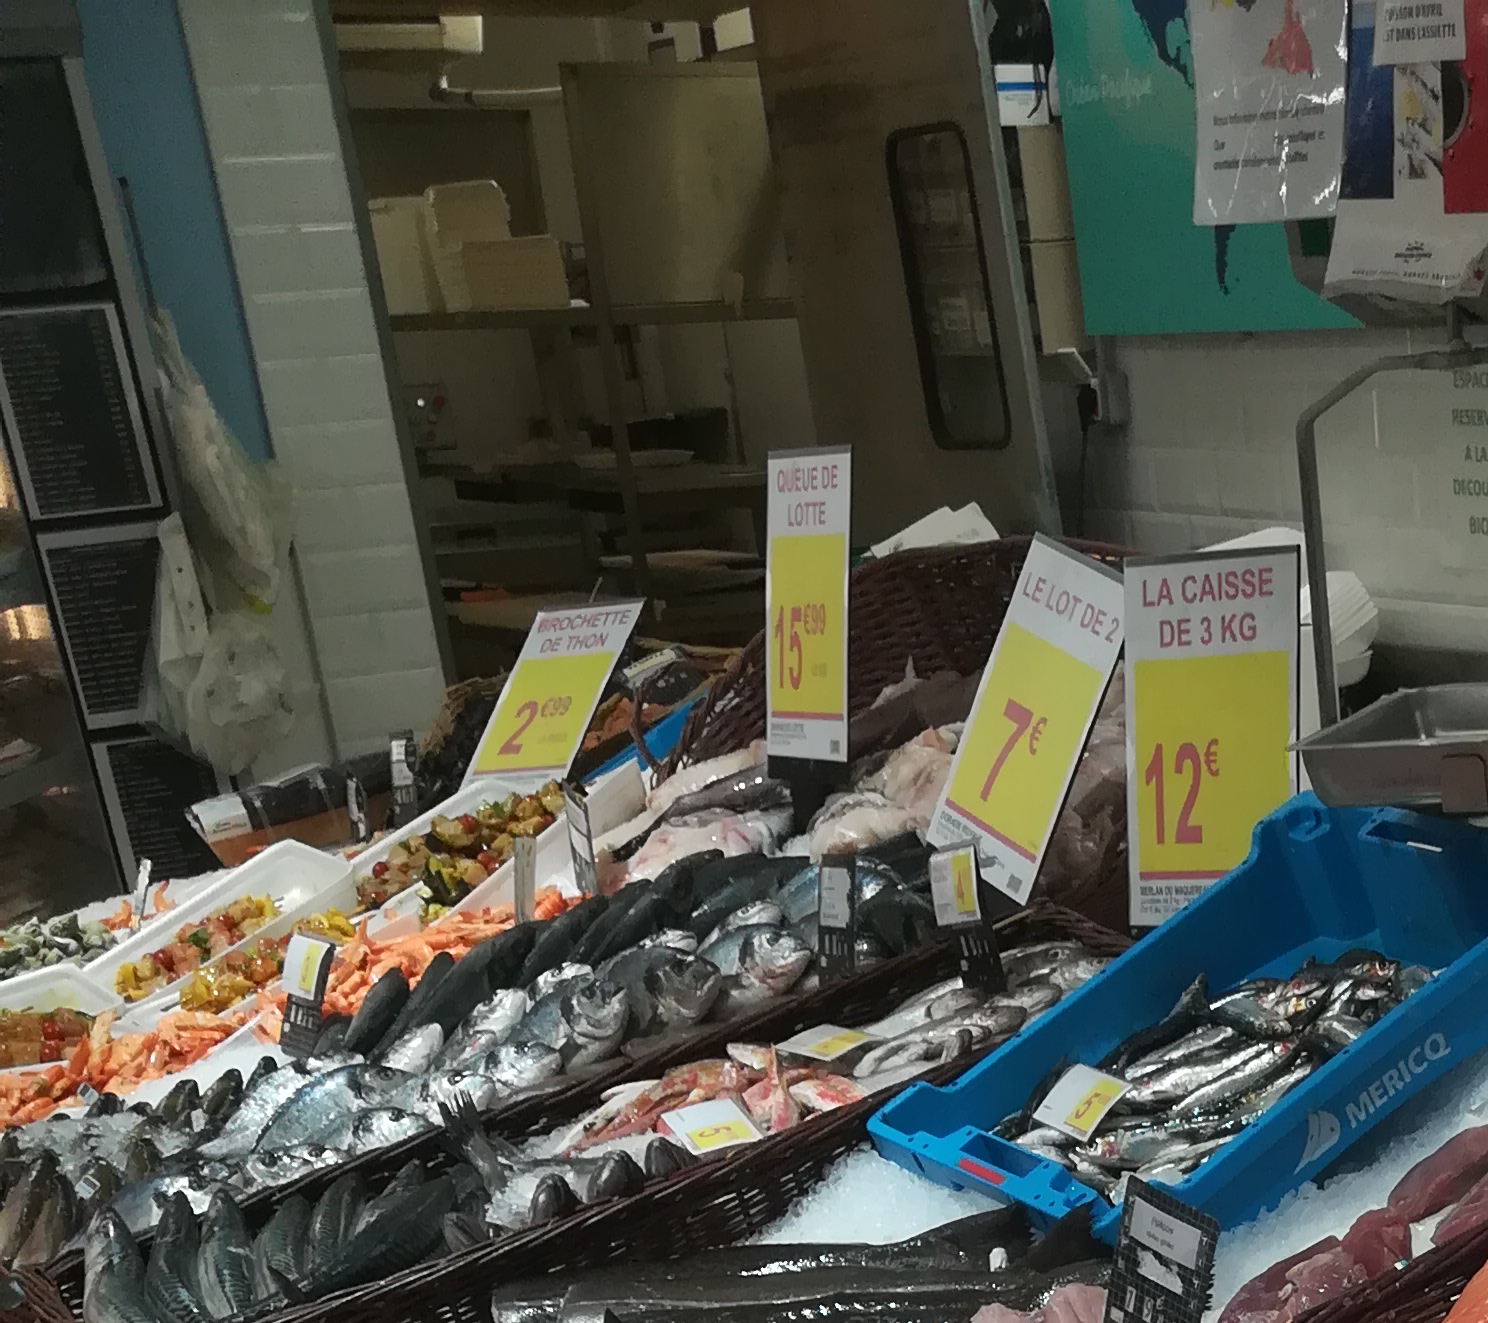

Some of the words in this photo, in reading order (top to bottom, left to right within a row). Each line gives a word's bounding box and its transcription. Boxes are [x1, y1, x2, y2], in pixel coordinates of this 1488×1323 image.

[1474, 446, 1488, 463] LA
[777, 466, 818, 493] QUEUE
[821, 464, 839, 489] DE
[787, 501, 827, 527] LOTTE
[1142, 578, 1173, 608] LA
[1181, 566, 1274, 604] CAISSE
[536, 609, 633, 634] BROCHETTE
[1022, 571, 1046, 599] LE
[1045, 584, 1080, 622] LOT
[1079, 602, 1104, 637] DE
[1105, 616, 1120, 645] 2
[539, 637, 562, 654] DE
[566, 632, 610, 651] THON
[1159, 618, 1192, 649] DE
[1199, 616, 1213, 646] 3
[1220, 612, 1258, 643] KG
[1344, 1032, 1452, 1129] MERICQ
